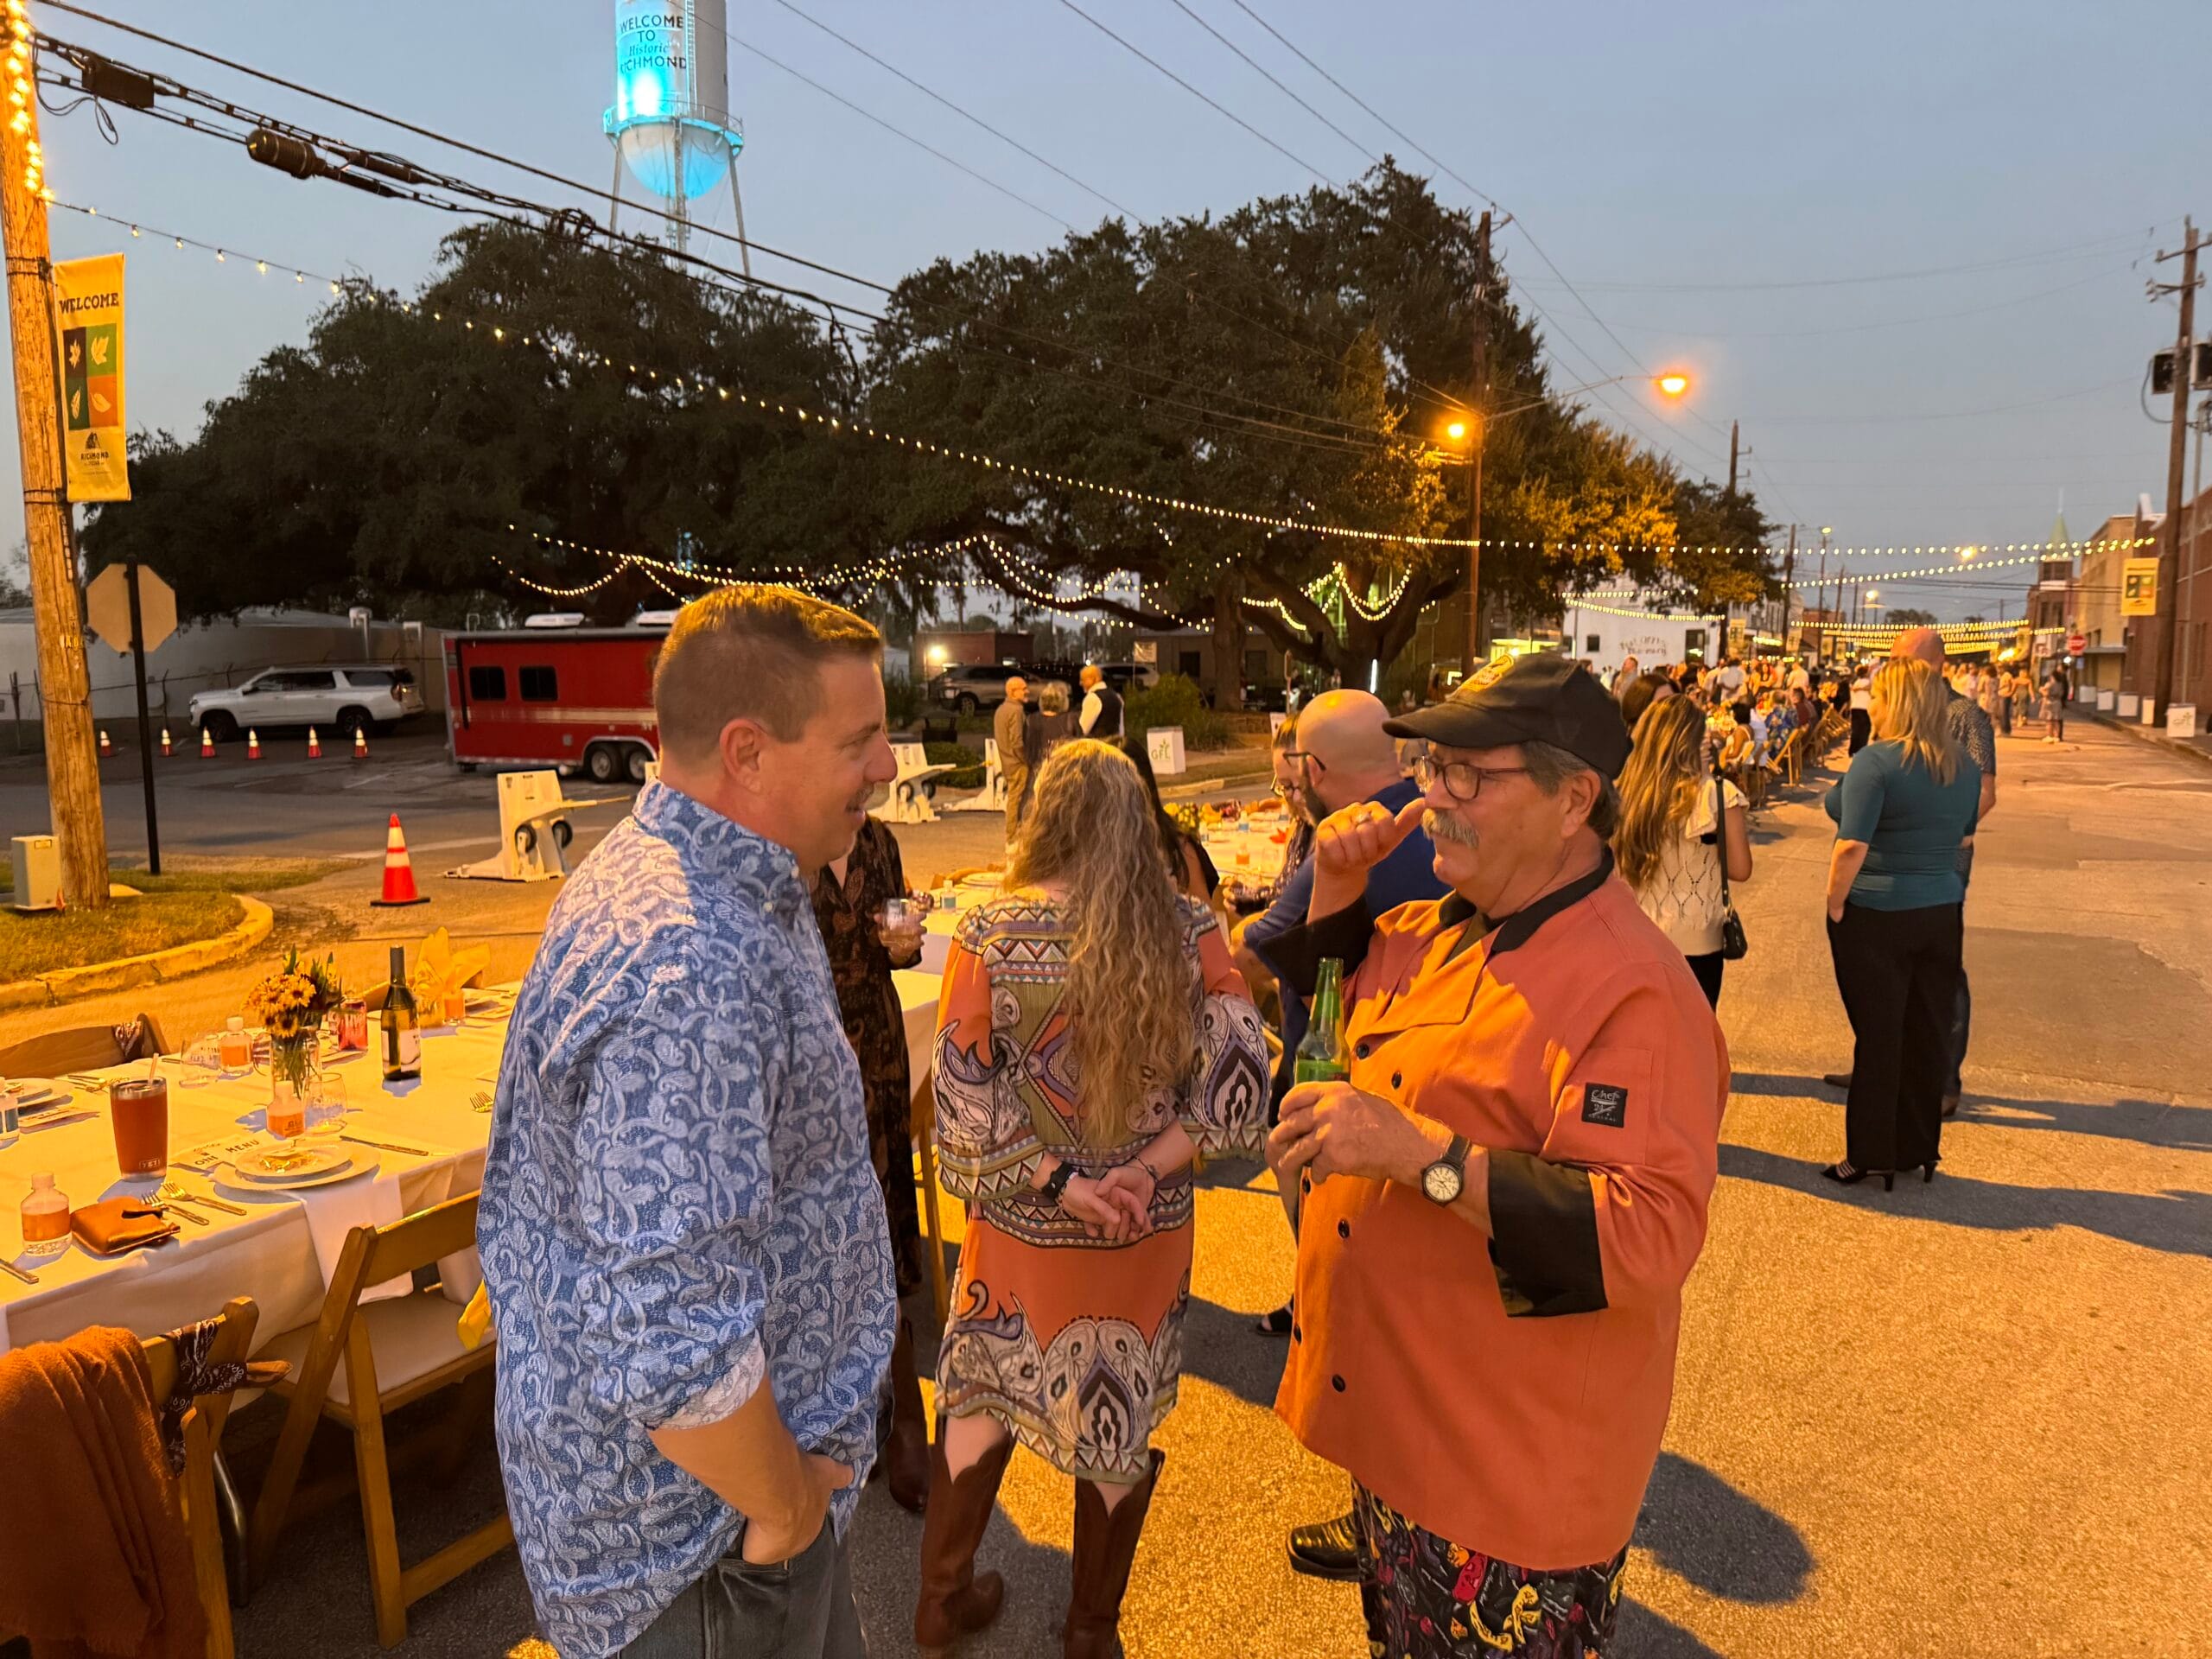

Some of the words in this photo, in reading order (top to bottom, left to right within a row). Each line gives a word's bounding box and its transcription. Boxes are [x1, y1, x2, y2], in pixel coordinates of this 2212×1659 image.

[620, 15, 683, 33] WELCOME
[638, 29, 656, 42] TO
[629, 43, 669, 56] Historic
[59, 293, 119, 314] WELCOME
[226, 1140, 259, 1153] MENU
